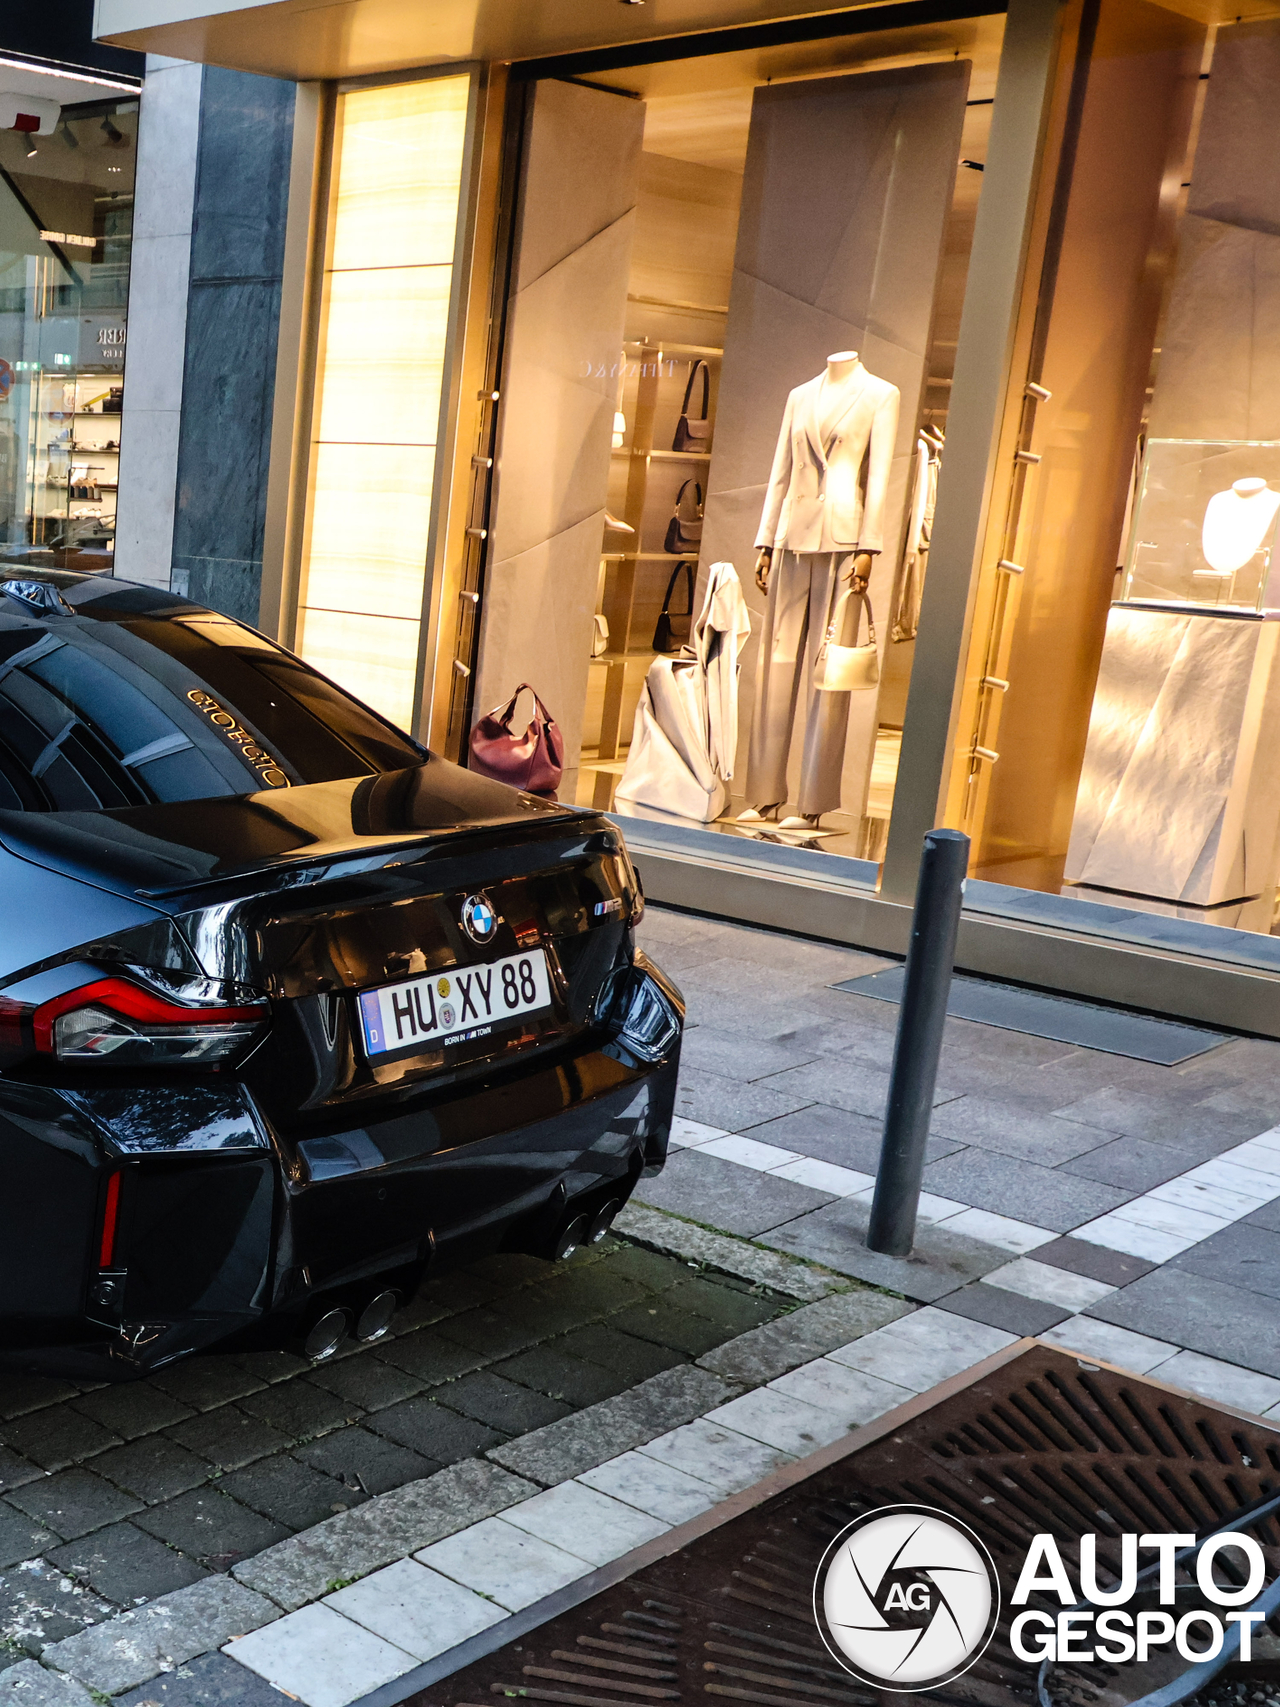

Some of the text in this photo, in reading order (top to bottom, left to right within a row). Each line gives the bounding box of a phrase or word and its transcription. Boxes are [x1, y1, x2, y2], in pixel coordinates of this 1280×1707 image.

[391, 958, 537, 1040] HU XY 88
[370, 1030, 378, 1043] D
[444, 1035, 460, 1046] BORN
[459, 1033, 466, 1042] IN
[476, 1026, 492, 1037] TOWN
